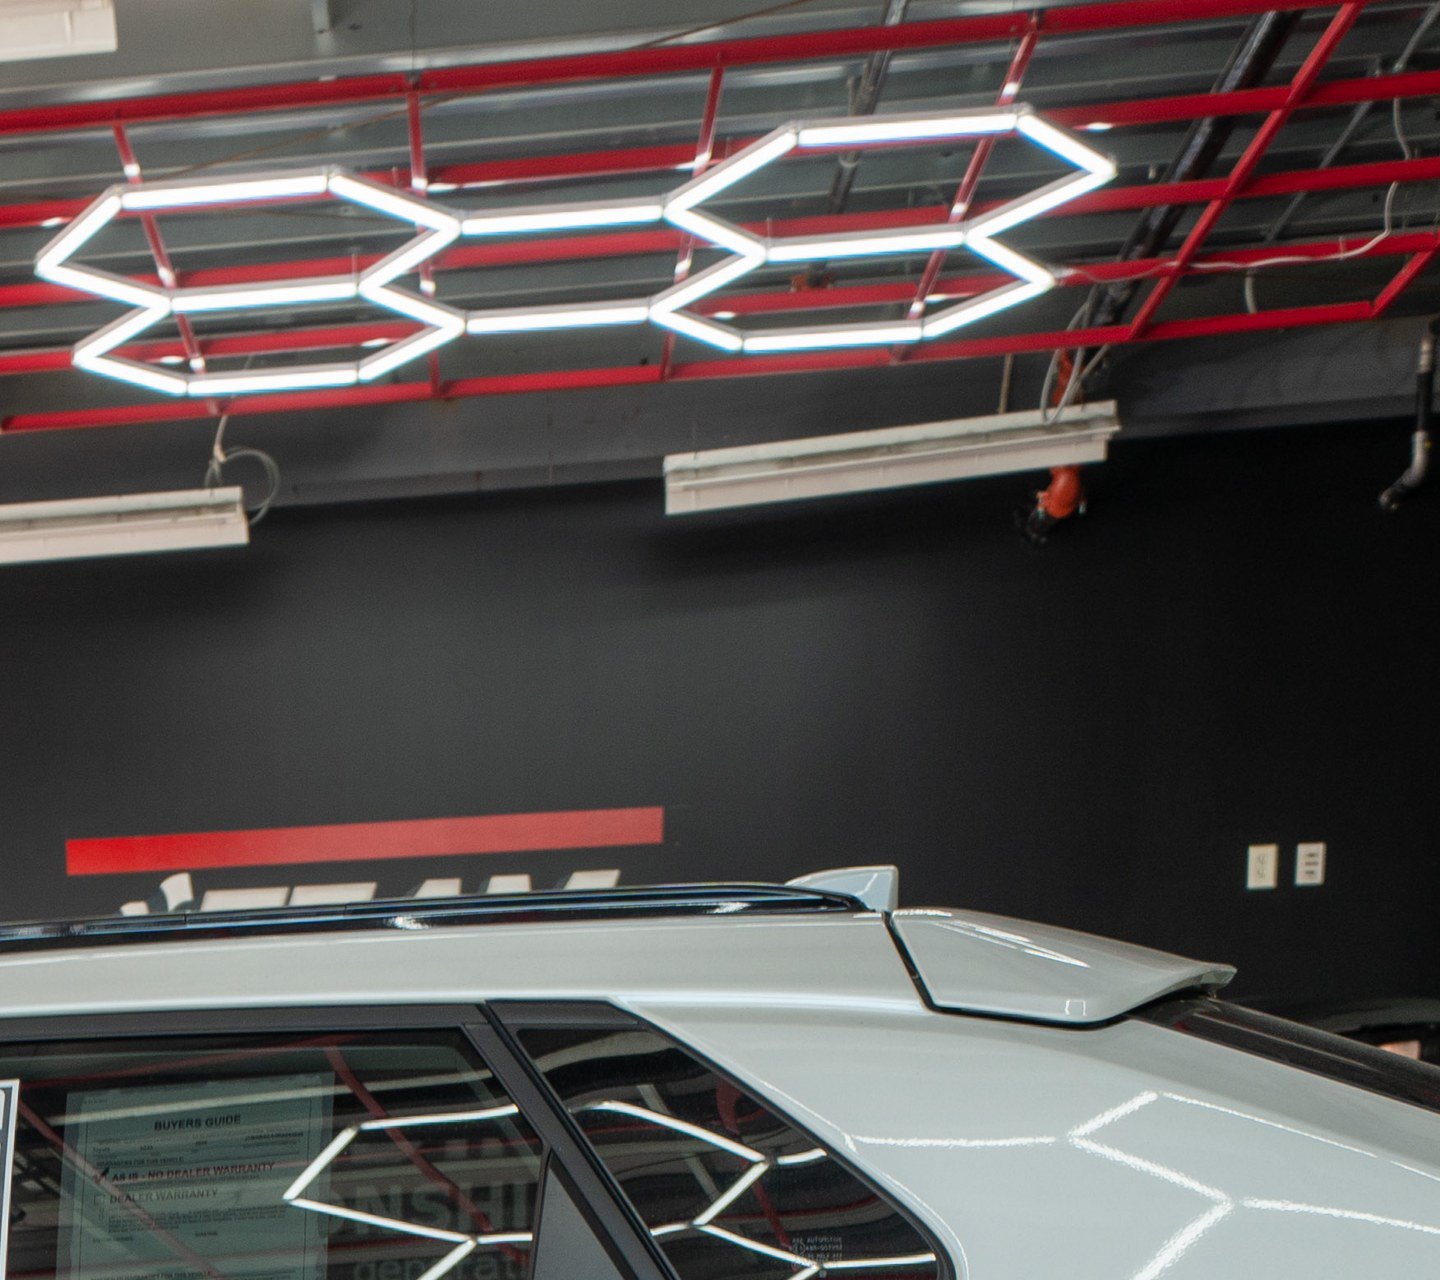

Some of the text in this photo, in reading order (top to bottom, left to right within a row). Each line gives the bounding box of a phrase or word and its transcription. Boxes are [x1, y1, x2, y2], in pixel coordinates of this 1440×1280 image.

[154, 1115, 241, 1131] BUYERS GUIDE
[148, 1169, 163, 1179] NO
[167, 1167, 211, 1178] DEALER
[213, 1162, 275, 1176] WARRANTY
[110, 1188, 218, 1204] DEALER WARRANTY
